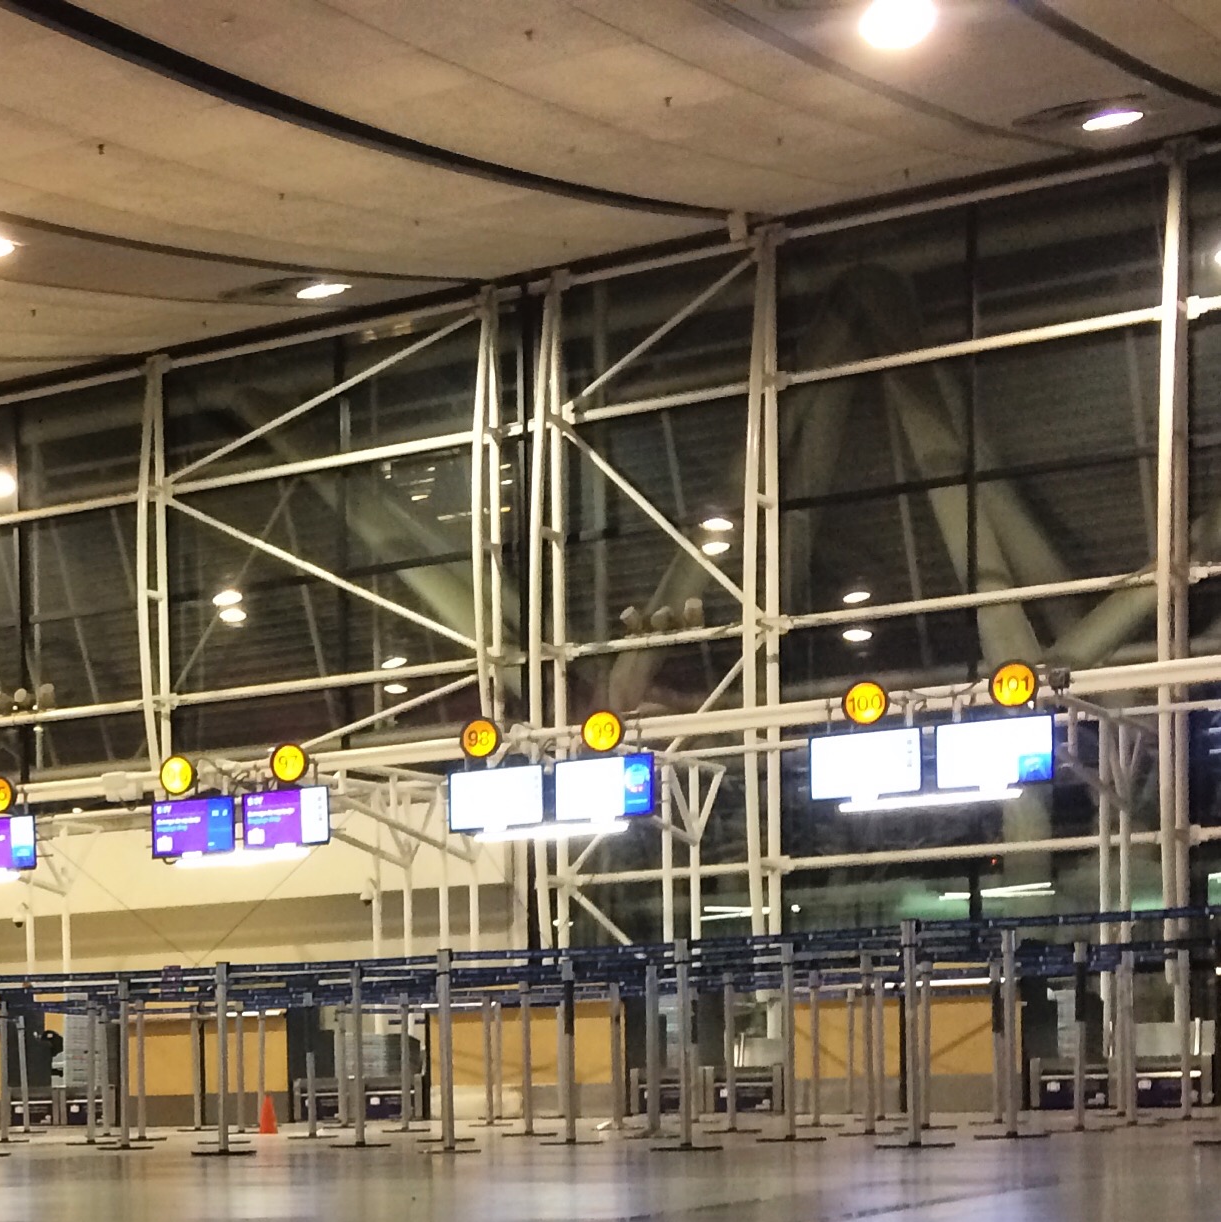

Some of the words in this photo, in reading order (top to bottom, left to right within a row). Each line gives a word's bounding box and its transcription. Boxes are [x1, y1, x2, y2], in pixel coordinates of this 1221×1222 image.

[995, 675, 1031, 693] 101
[848, 693, 884, 713] 100
[467, 728, 490, 746] 98
[591, 721, 615, 739] 99
